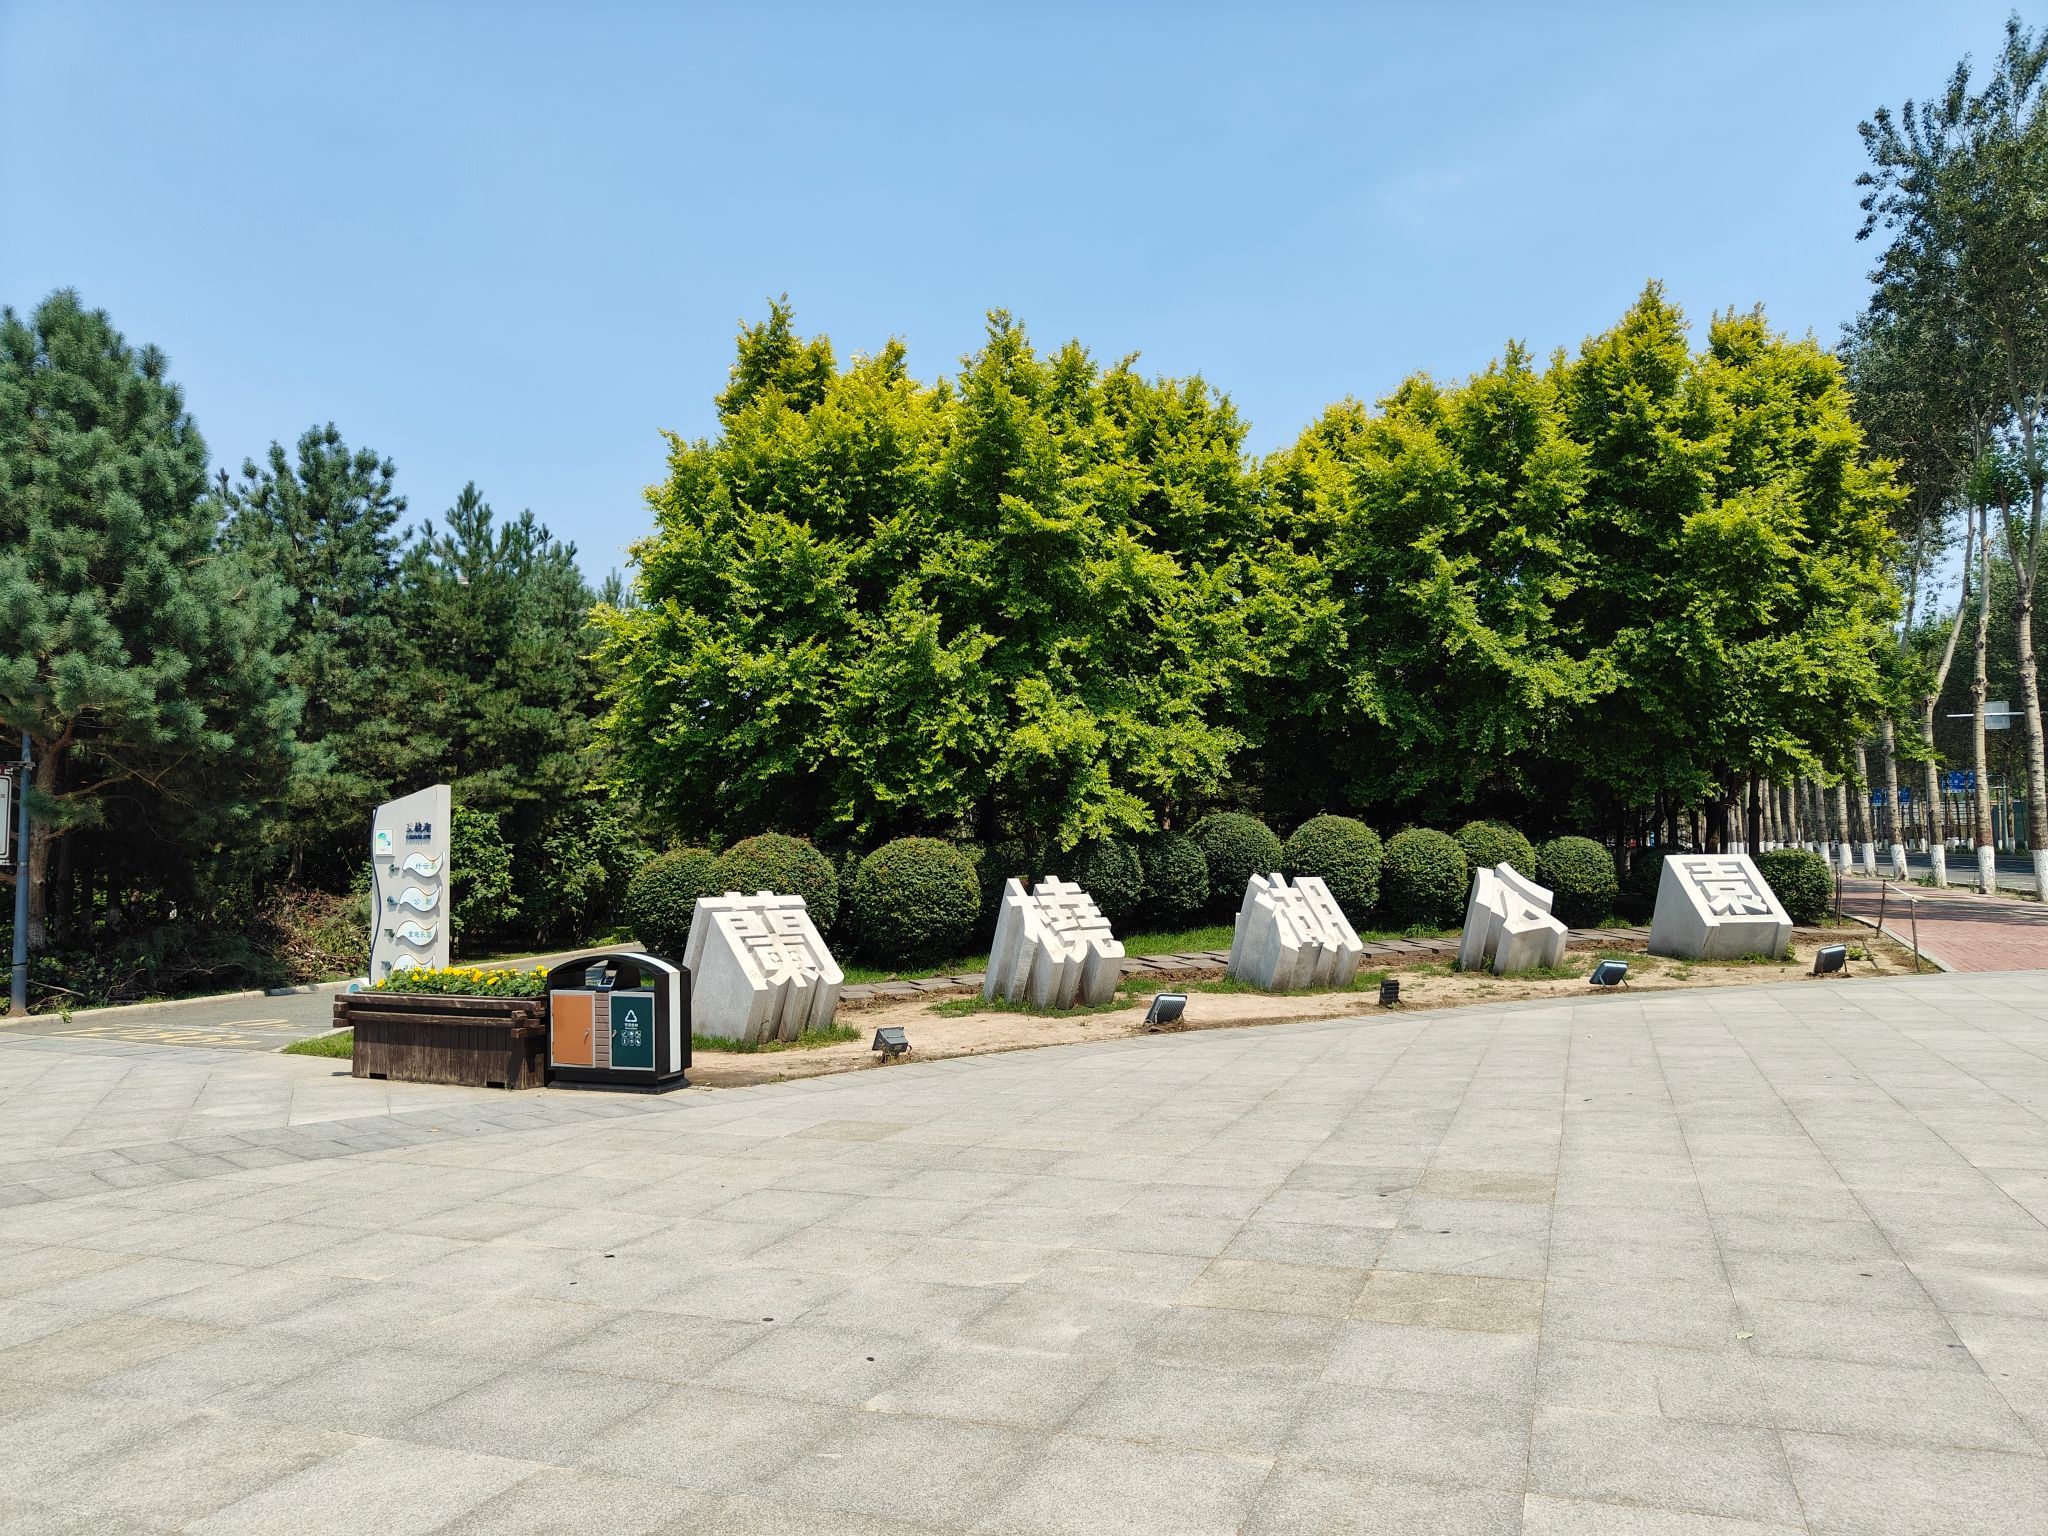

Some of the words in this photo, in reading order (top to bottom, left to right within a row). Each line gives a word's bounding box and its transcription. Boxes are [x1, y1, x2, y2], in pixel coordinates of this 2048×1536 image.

[697, 891, 844, 991] 蘭
[1249, 872, 1364, 952] 湖
[1475, 862, 1568, 935] 公
[1664, 854, 1794, 926] 園
